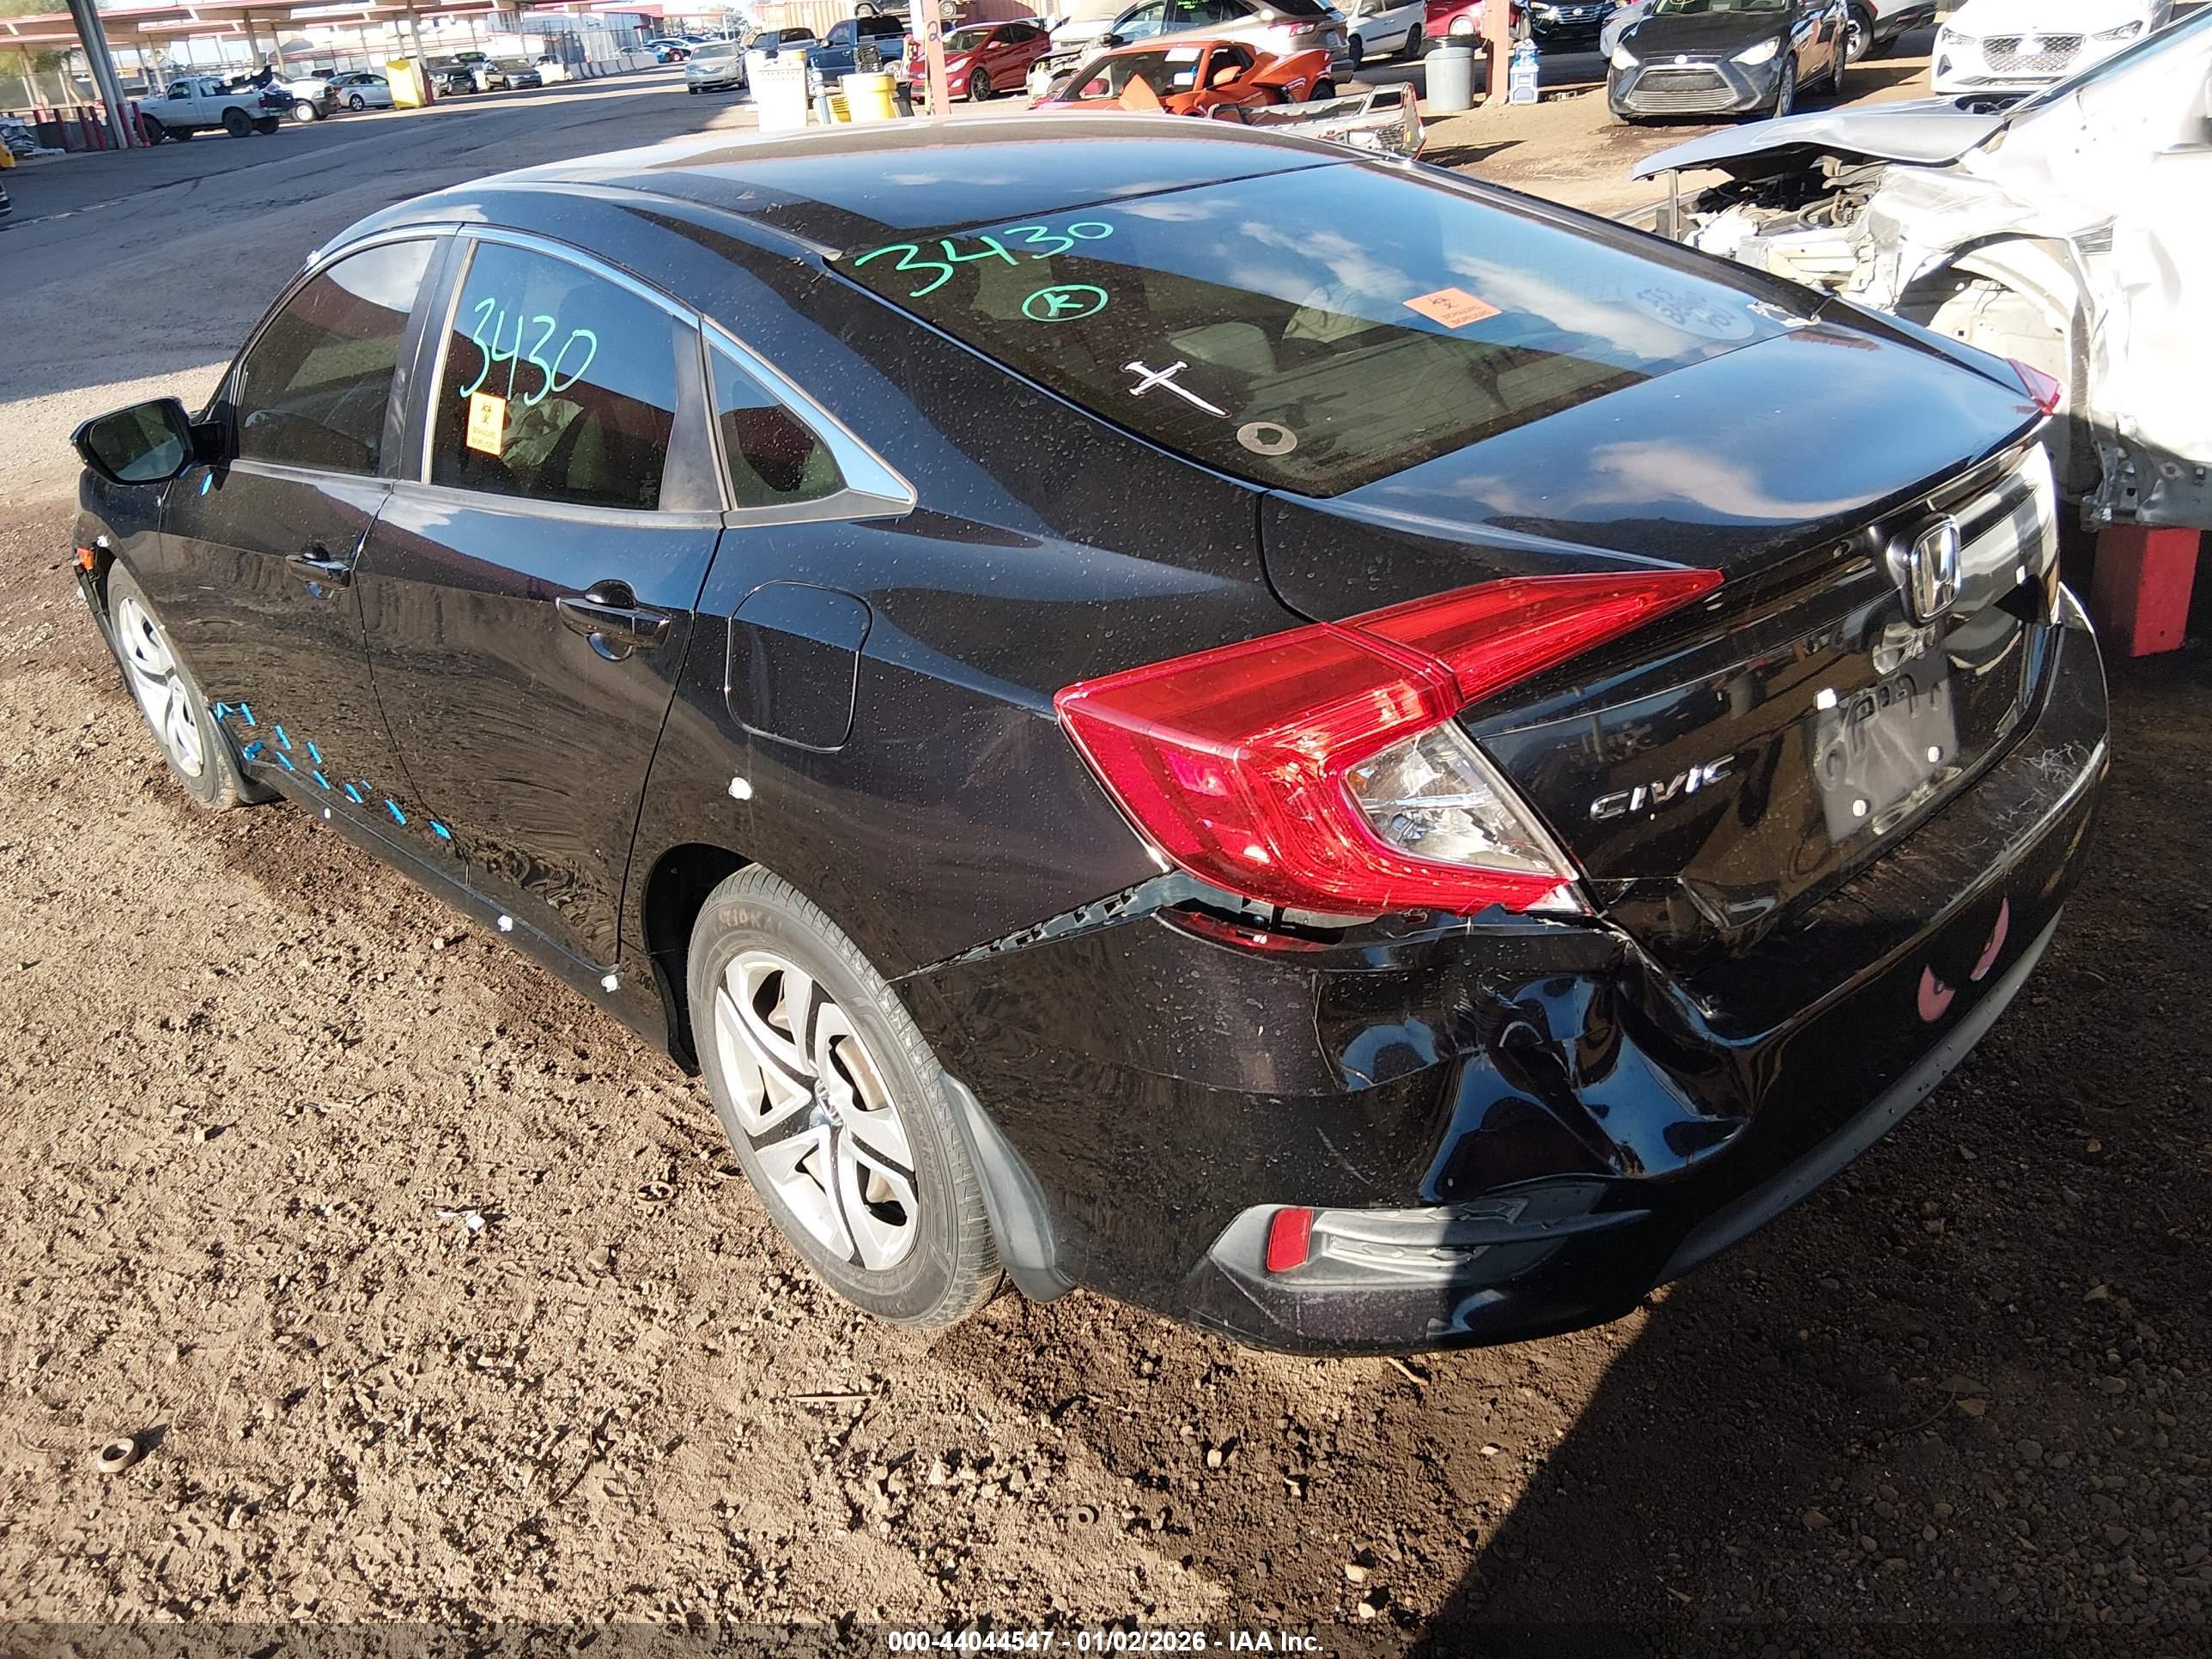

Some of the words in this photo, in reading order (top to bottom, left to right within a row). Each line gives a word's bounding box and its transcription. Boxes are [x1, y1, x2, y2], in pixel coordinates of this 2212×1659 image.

[927, 20, 941, 42] 2
[854, 221, 1115, 298] 3430
[459, 297, 598, 407] 3430
[1589, 753, 1736, 822] CIVIC
